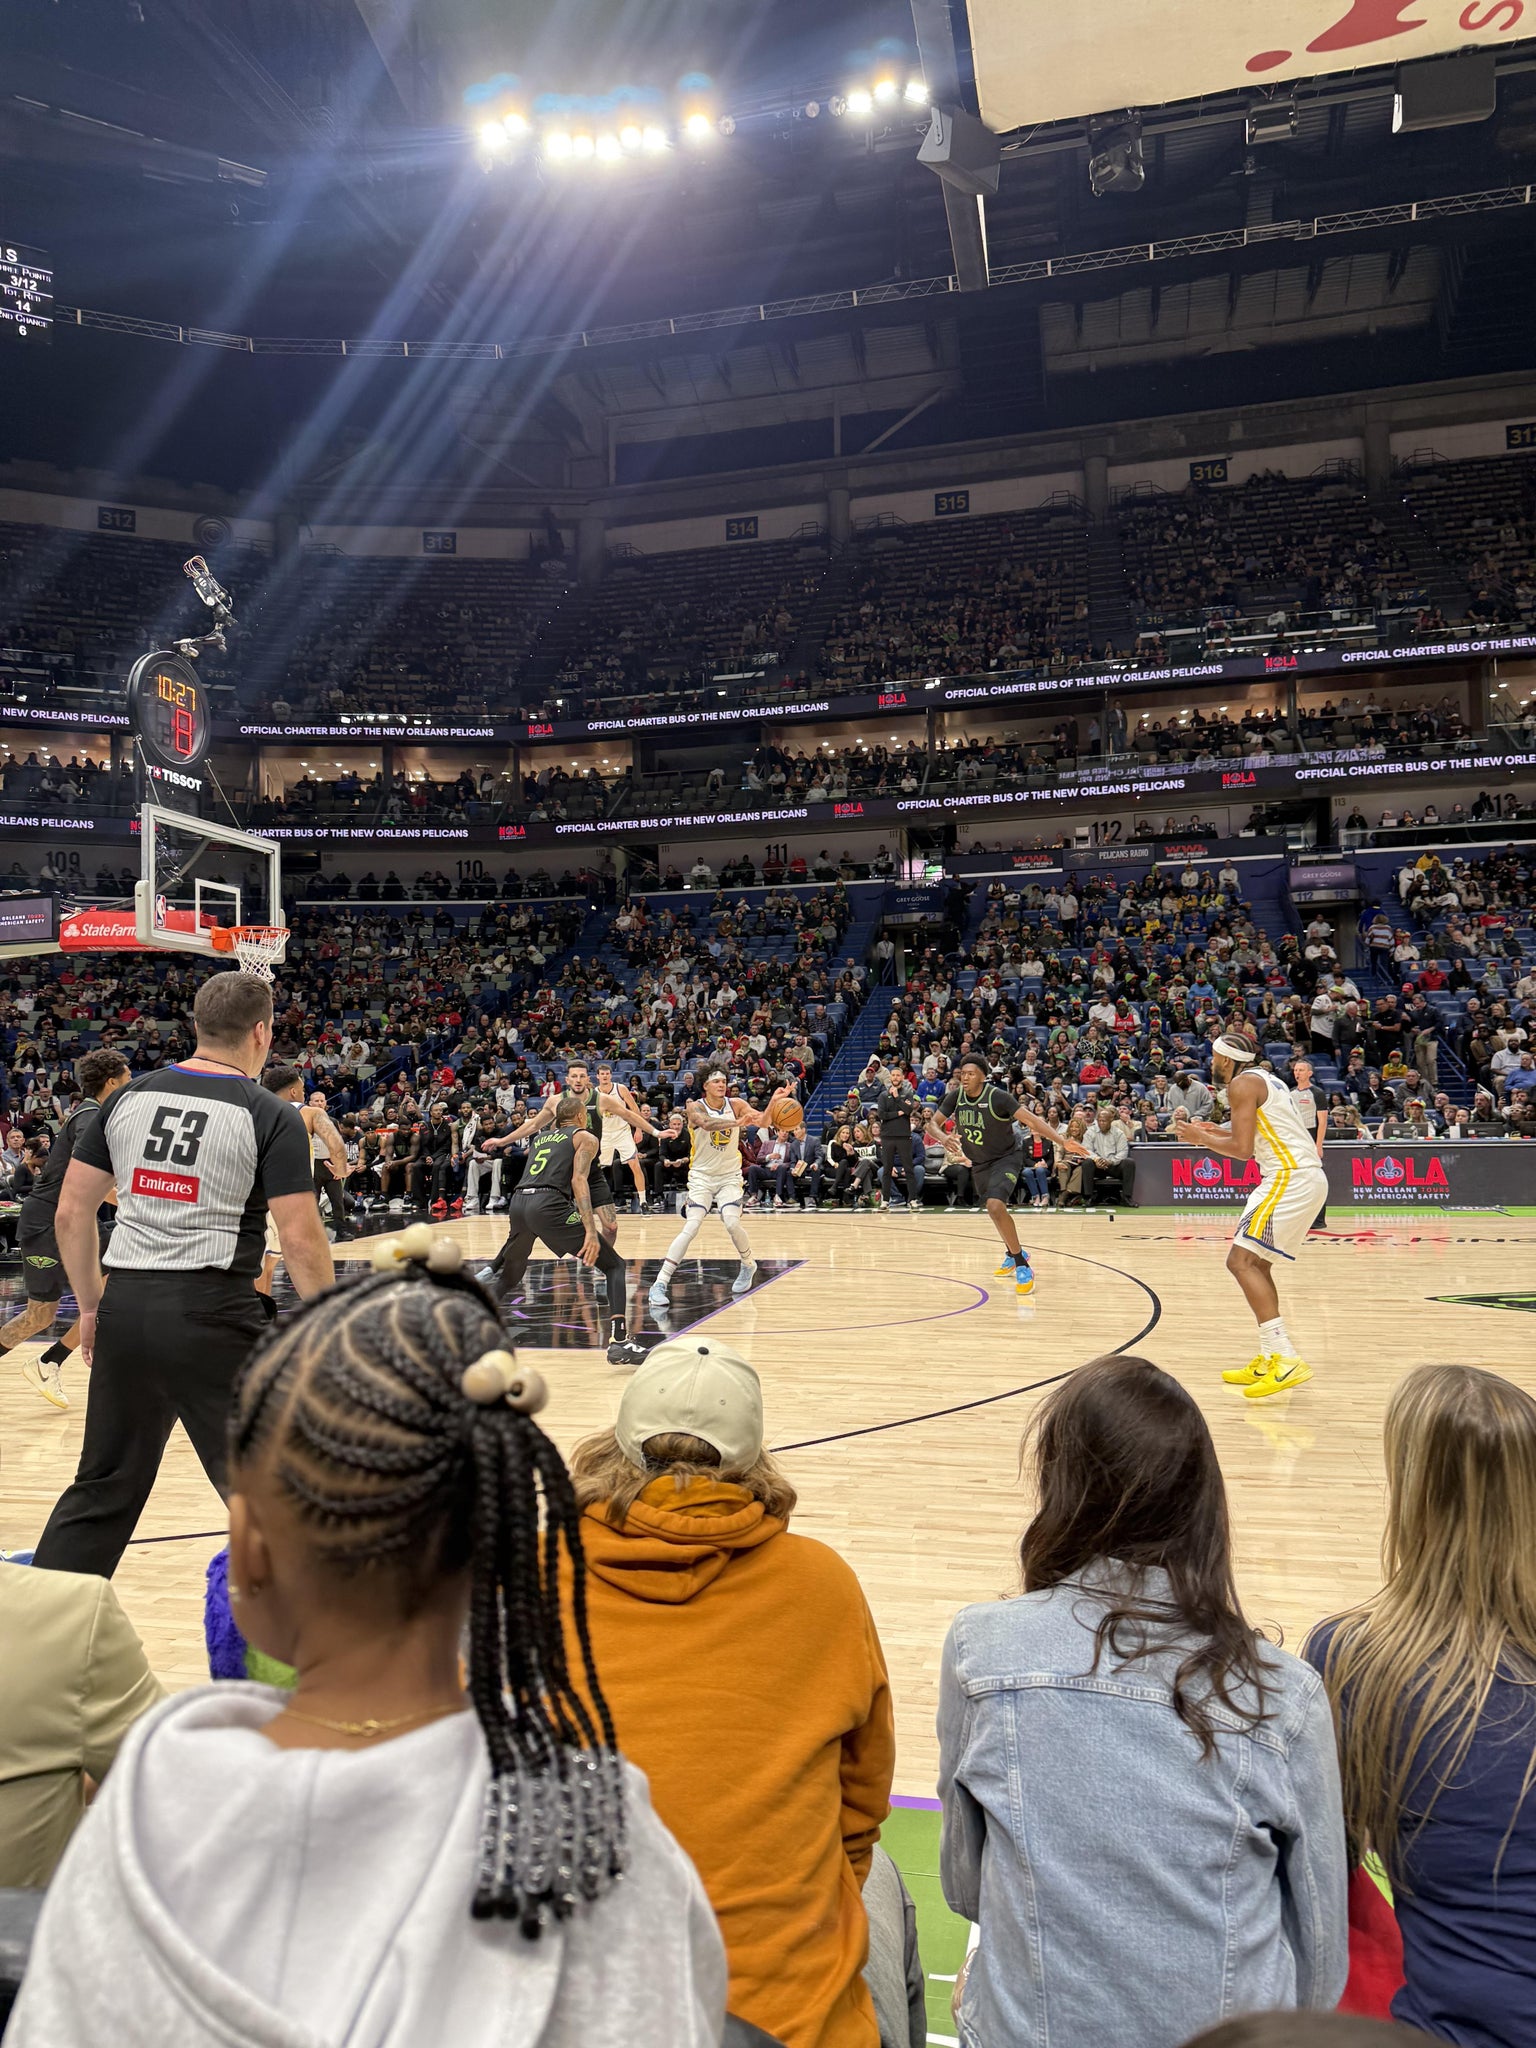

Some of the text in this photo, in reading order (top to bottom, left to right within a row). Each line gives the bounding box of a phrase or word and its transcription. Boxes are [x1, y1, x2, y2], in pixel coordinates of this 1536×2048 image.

[10, 275, 38, 291] 3/12
[15, 300, 31, 313] 14
[18, 325, 28, 336] 6
[1510, 427, 1536, 444] 31
[1192, 466, 1225, 481] 316
[937, 495, 967, 511] 315
[101, 511, 133, 527] 312
[728, 522, 756, 536] 314
[425, 536, 454, 549] 313
[1341, 637, 1536, 662] OFFICIAL CHARTER BUS OF THE NEW
[945, 664, 1223, 700] OFFICIAL CHARTER BUS OF THE NEW ORLEANS PELICANS
[158, 674, 196, 712] 10:27
[3, 707, 130, 725] NEW ORLEANS PELICANS
[587, 702, 829, 731] OFFICIAL CHARTER BUS OF THE NEW ORLEANS PELICANS
[175, 708, 192, 756] 8
[240, 726, 494, 737] OFFICIAL CHARTER BUS OF THE NEW ORLEANS PELICANS
[1295, 766, 1348, 780] OFFICIAL
[1349, 762, 1403, 776] CHARTER
[1405, 760, 1429, 772] BUS
[1430, 759, 1447, 770] OF
[1448, 758, 1472, 768] THE
[1473, 756, 1503, 767] NEW
[161, 768, 202, 791] TISSOT
[897, 778, 1186, 810] OFFICIAL CHARTER BUS OF THE NEW ORLEANS PELICANS
[41, 818, 94, 829] PELICANS
[555, 808, 807, 834] OFFICIAL CHARTER BUS OF THE NEW ORLEANS PELICANS
[1091, 820, 1122, 842] 112
[246, 828, 469, 838] CHARTER BUS OF THE NEW ORLEANS PELICANS
[45, 851, 81, 874] 109
[1098, 848, 1149, 859] PELICANS RADIO
[456, 859, 483, 880] 110
[143, 1105, 209, 1167] 53
[964, 1128, 984, 1146] 22
[529, 1148, 551, 1176] 5
[1171, 1157, 1262, 1187] NOLA
[1351, 1156, 1449, 1187] NOLA
[138, 1174, 193, 1196] Emirates
